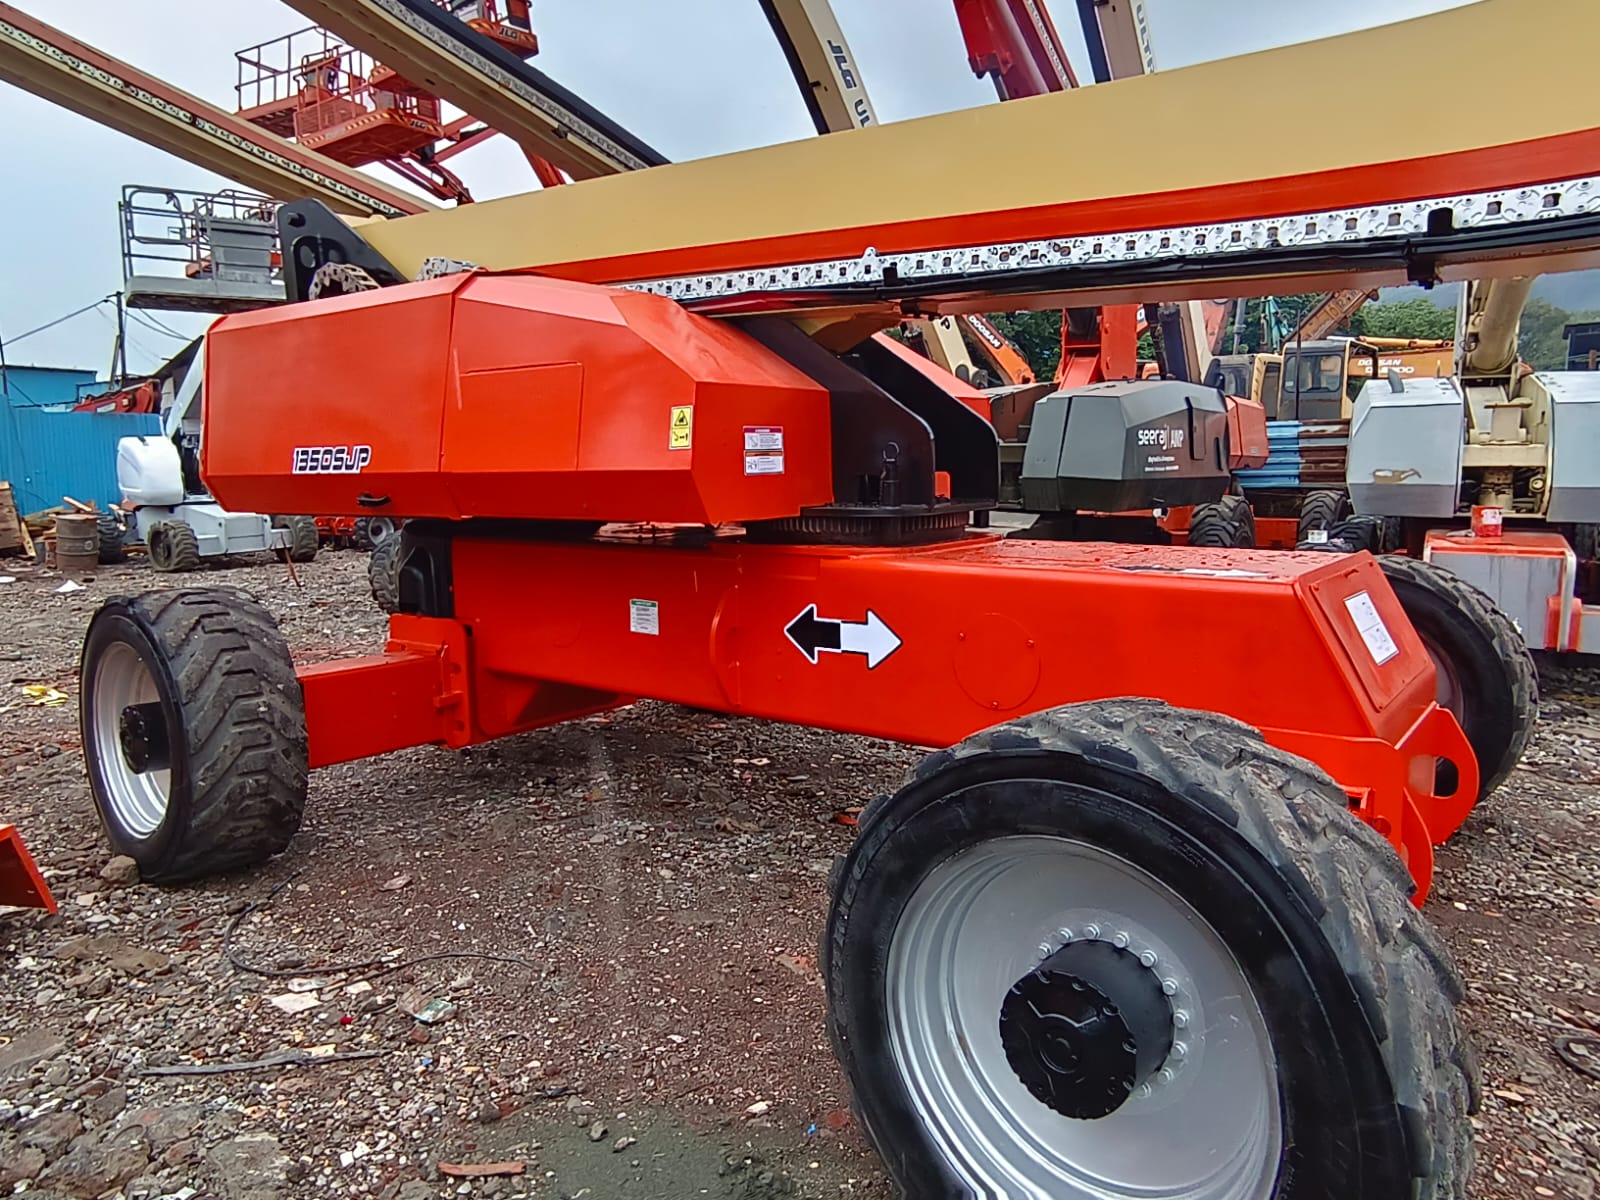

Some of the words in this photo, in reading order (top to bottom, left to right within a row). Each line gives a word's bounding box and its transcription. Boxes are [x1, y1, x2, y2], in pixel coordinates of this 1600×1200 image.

[498, 28, 518, 40] JLG
[827, 39, 858, 89] JLG
[968, 315, 1002, 348] DOOSAN
[1357, 359, 1402, 367] DOSAN
[1137, 424, 1168, 451] seeraj
[293, 446, 371, 473] 1350SJP
